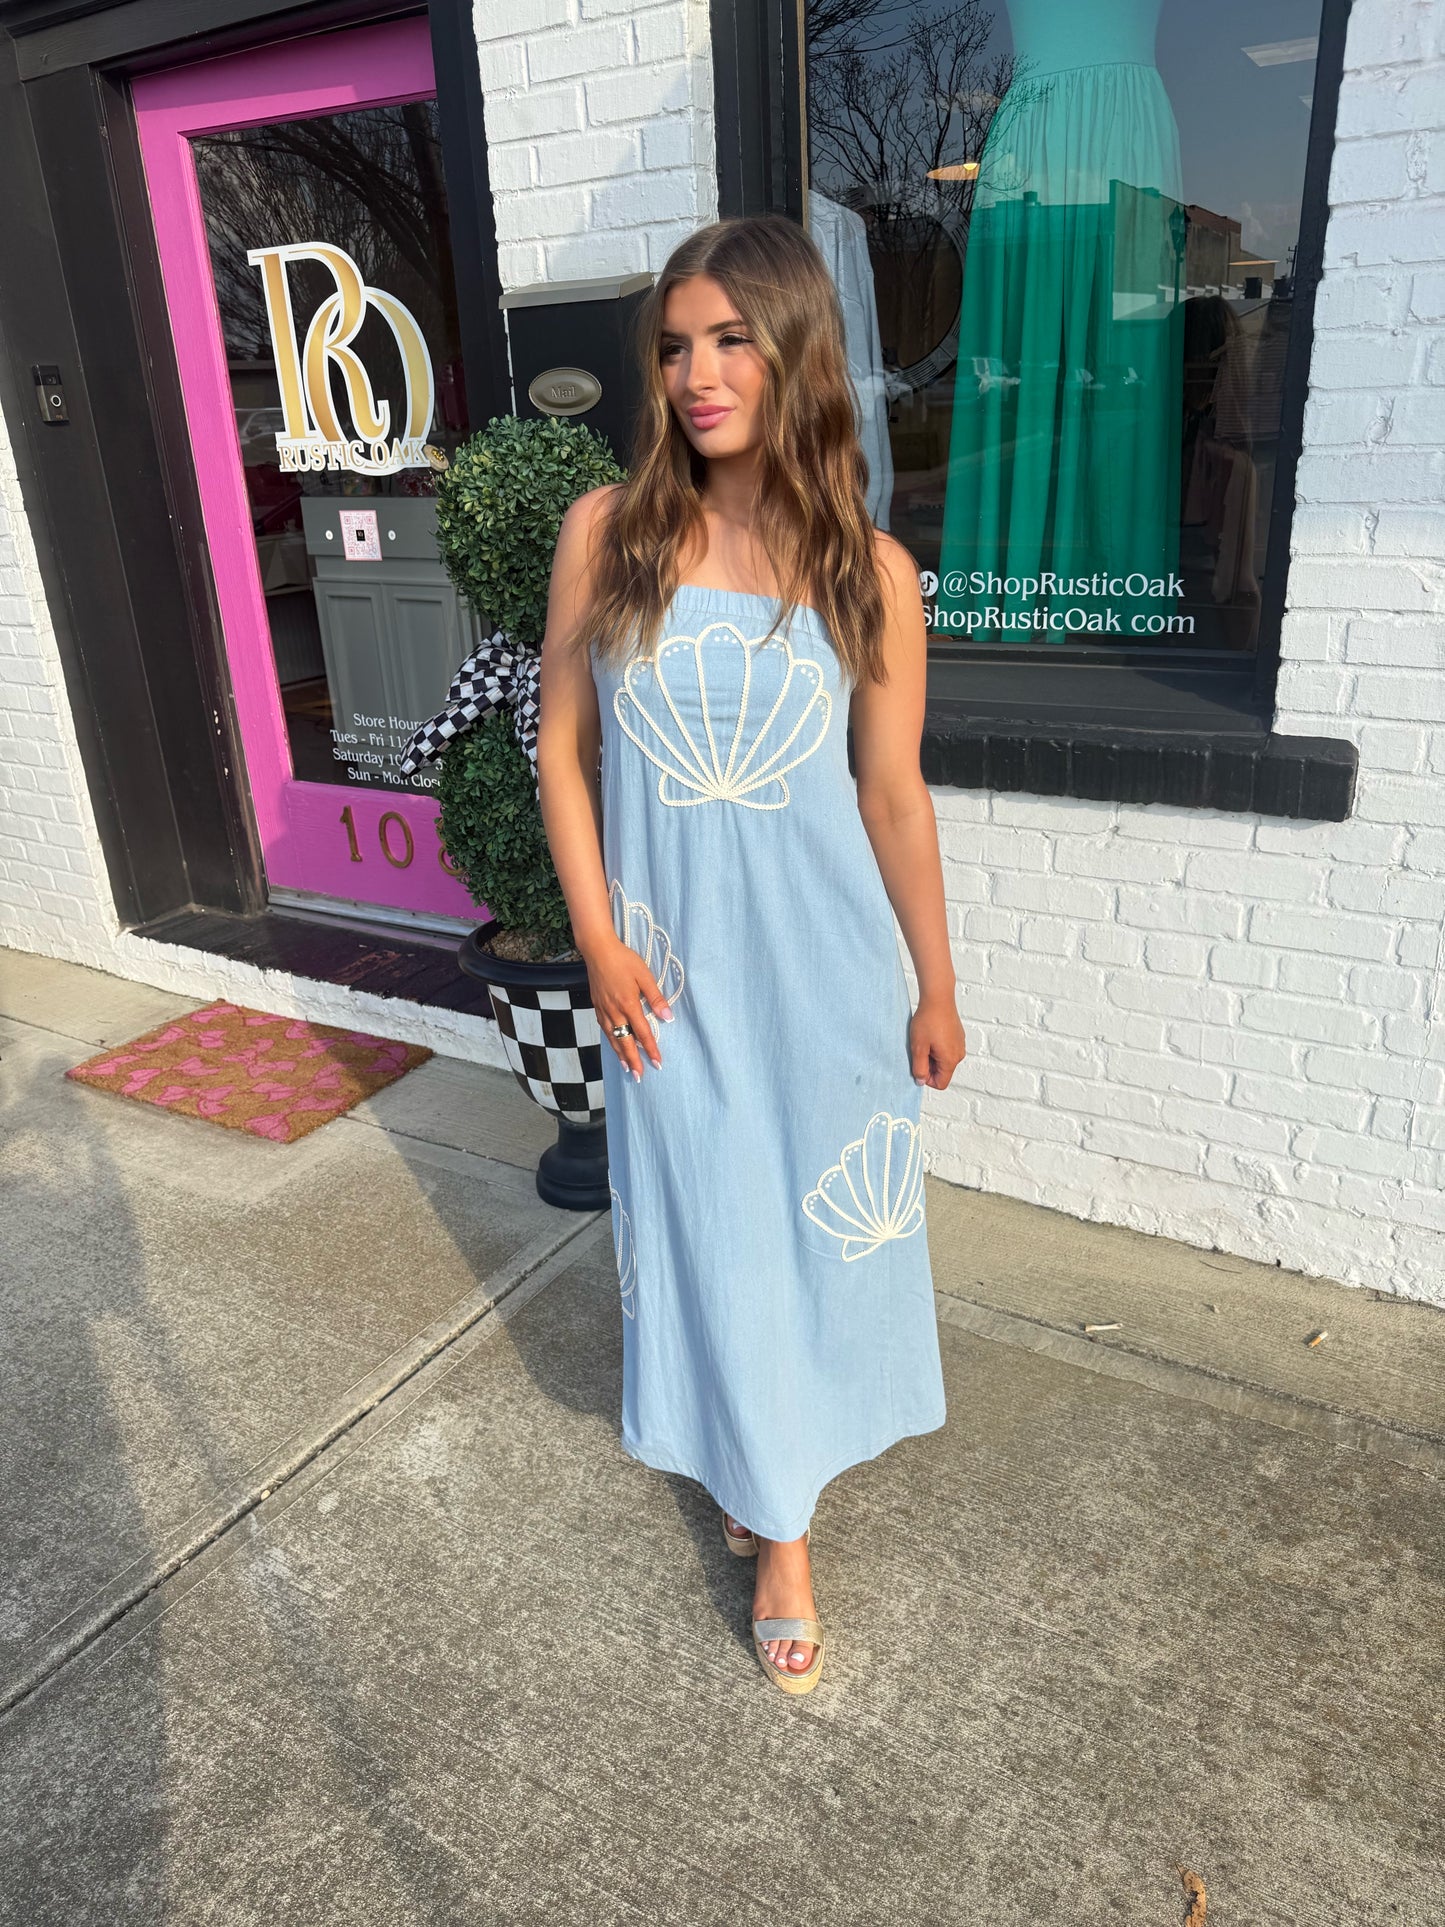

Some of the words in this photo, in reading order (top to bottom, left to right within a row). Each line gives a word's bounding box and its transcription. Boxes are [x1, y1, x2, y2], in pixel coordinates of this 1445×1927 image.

[551, 385, 577, 399] Mail
[276, 440, 366, 471] RUSTIC
[369, 437, 431, 468] OAK
[942, 570, 1186, 601] @ShopRusticOak
[1130, 614, 1196, 634] com
[353, 712, 386, 729] Store
[330, 729, 358, 744] Tues
[369, 732, 385, 747] Fri
[332, 747, 384, 768] Saturday
[347, 766, 371, 782] Sun
